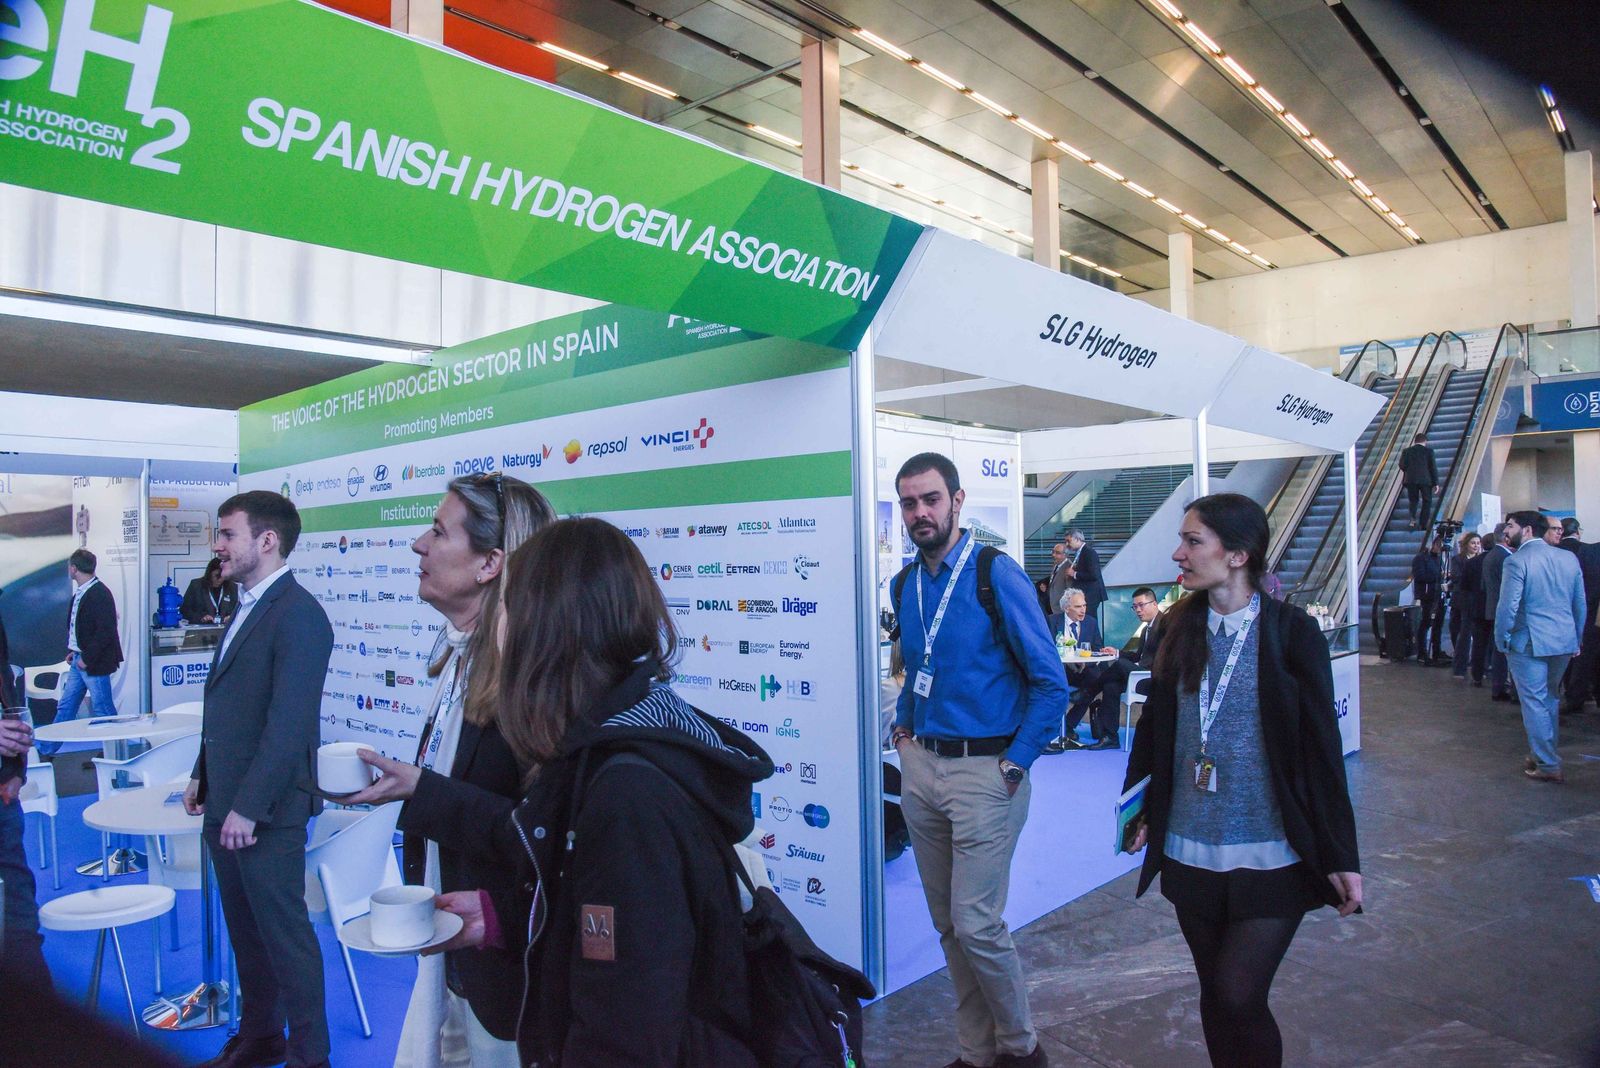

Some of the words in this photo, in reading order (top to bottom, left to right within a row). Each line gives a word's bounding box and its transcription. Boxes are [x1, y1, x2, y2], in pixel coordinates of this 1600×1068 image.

[16, 103, 128, 143] HYDROGEN
[241, 97, 472, 196] SPANISH
[470, 162, 693, 254] HYDROGEN
[687, 226, 879, 303] ASSOCIATION
[1039, 313, 1084, 347] SLG
[1080, 326, 1158, 370] Hydrogen
[271, 414, 290, 431] THE
[291, 406, 322, 427] VOICE
[324, 399, 340, 418] OF
[340, 395, 366, 414] THE
[368, 369, 449, 406] HYDROGEN
[452, 354, 522, 386] SECTOR
[526, 343, 546, 368] IN
[553, 321, 619, 361] SPAIN
[1276, 394, 1299, 414] SLG
[1297, 398, 1334, 426] Hydrogen
[385, 416, 438, 440] Promoting
[440, 403, 494, 428] Members
[673, 444, 695, 453] ENERGIES
[370, 482, 393, 493] HYUNDAI
[415, 463, 445, 481] Iberdrola
[453, 455, 495, 478] moeve
[502, 452, 542, 472] Naturgy
[587, 437, 628, 463] repsol
[641, 429, 689, 448] VINCI
[982, 458, 1009, 477] SLG
[699, 524, 728, 537] atawey
[737, 521, 772, 533] ATECSOL
[778, 516, 817, 529] Atlantica
[673, 565, 693, 573] CENER
[696, 600, 733, 612] DORAL
[782, 597, 818, 617] Dräger
[779, 640, 810, 650] Eurowind
[718, 678, 757, 693] H2GREEN
[742, 722, 769, 734] IDOM
[775, 726, 801, 738] IGNIS
[785, 843, 825, 863] STÄUBLI
